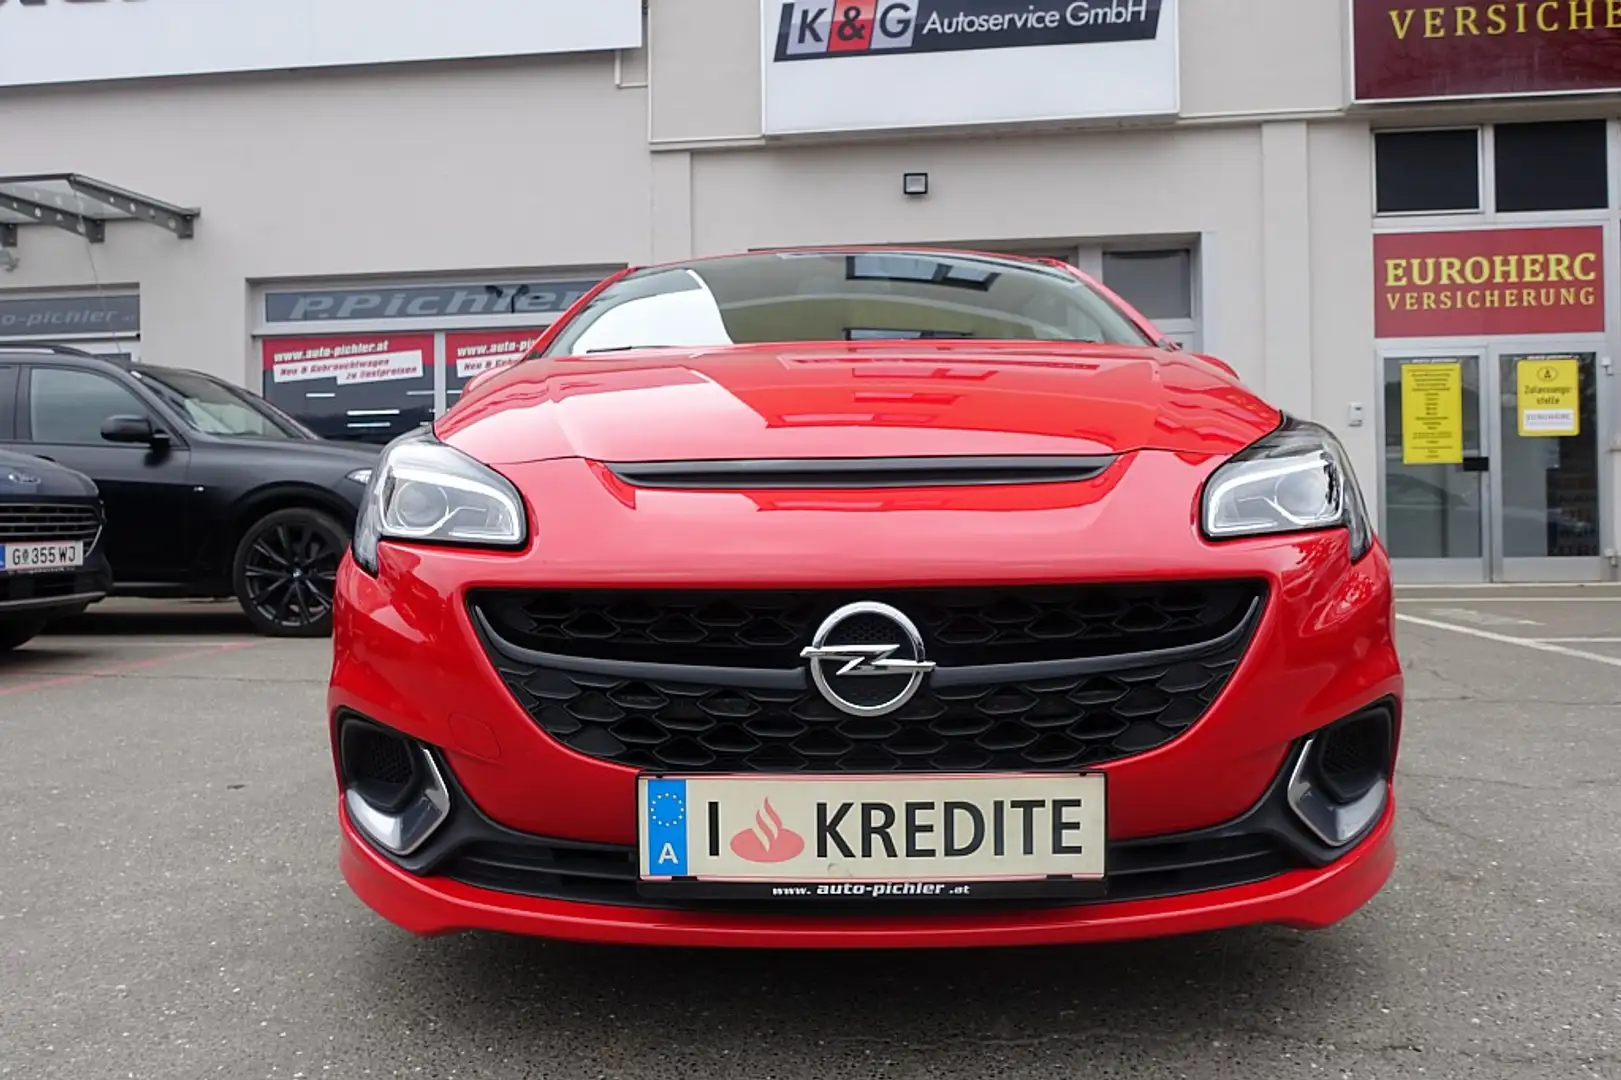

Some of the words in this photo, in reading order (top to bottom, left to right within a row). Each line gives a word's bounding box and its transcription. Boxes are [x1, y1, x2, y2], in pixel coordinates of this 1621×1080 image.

[922, 4, 1060, 35] Autoservice
[1066, 0, 1146, 27] GmbH
[1385, 252, 1597, 286] EUROHERC
[1386, 287, 1596, 311] VERSICHERUNG
[273, 340, 389, 363] www.auto-pichler.at
[815, 798, 1083, 859] KREDITE
[657, 842, 679, 864] A
[816, 882, 945, 897] auto-pichler
